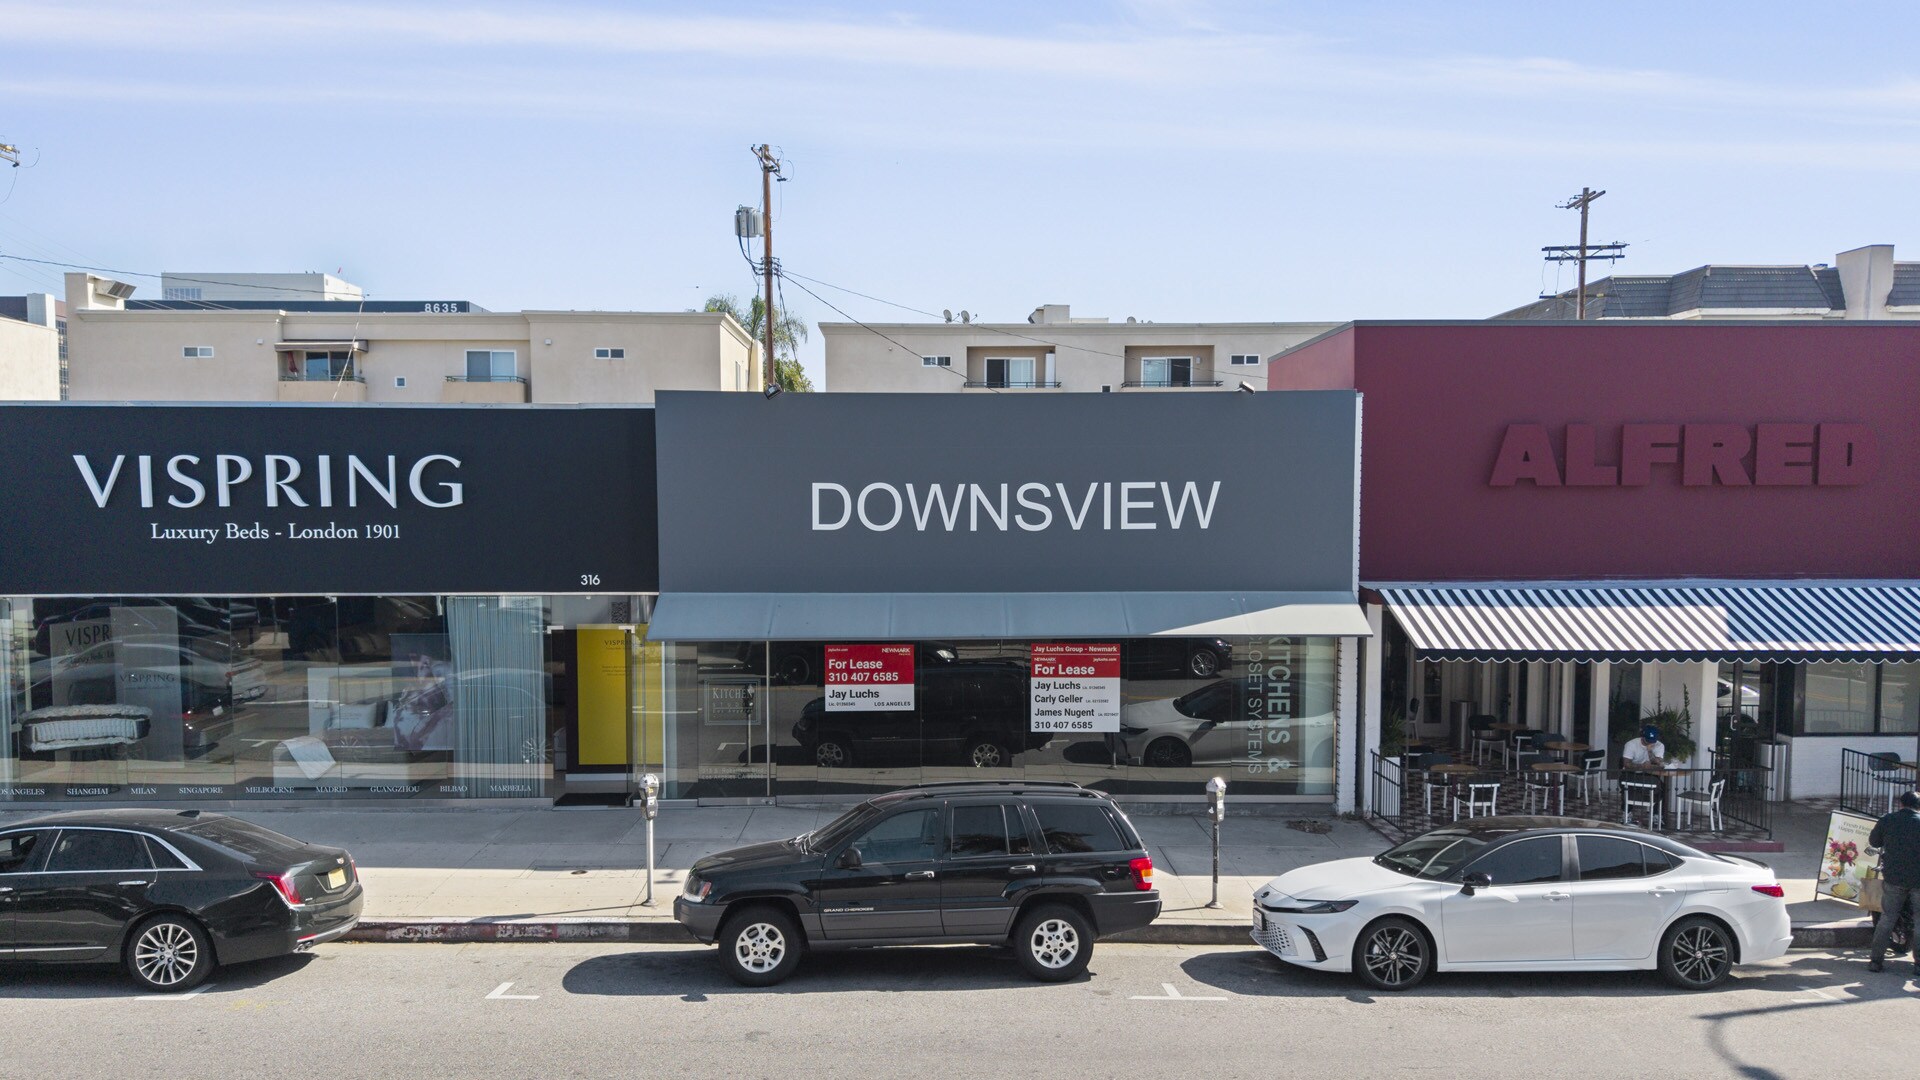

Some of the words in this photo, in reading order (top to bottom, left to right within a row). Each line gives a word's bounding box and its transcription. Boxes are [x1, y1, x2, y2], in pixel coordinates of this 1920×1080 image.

[424, 303, 458, 313] 8635
[1489, 423, 1876, 487] ALFRED
[73, 454, 464, 509] VISPRING
[811, 480, 1222, 532] DOWNSVIEW
[150, 522, 220, 545] Luxury
[226, 521, 270, 540] Beds
[288, 521, 359, 540] London
[365, 523, 400, 540] 1901
[580, 574, 601, 586] 316
[66, 625, 112, 646] VISPR
[828, 659, 847, 669] For
[849, 659, 883, 669] Lease
[1035, 664, 1055, 675] For
[1058, 664, 1095, 675] Lease
[828, 672, 848, 682] 310
[850, 672, 870, 682] 407
[872, 672, 899, 682] 6585
[1034, 681, 1051, 691] Jay
[1053, 681, 1081, 690] Luchs
[828, 689, 847, 700] Jay
[849, 689, 880, 699] Luchs
[1034, 694, 1056, 704] Carly
[1058, 694, 1083, 703] Geller
[1034, 708, 1062, 717] James
[1064, 708, 1095, 718] Nugent
[1034, 721, 1051, 729] 310
[1053, 721, 1069, 729] 407
[1071, 721, 1093, 729] 6585
[1247, 697, 1262, 774] SYSTEMS
